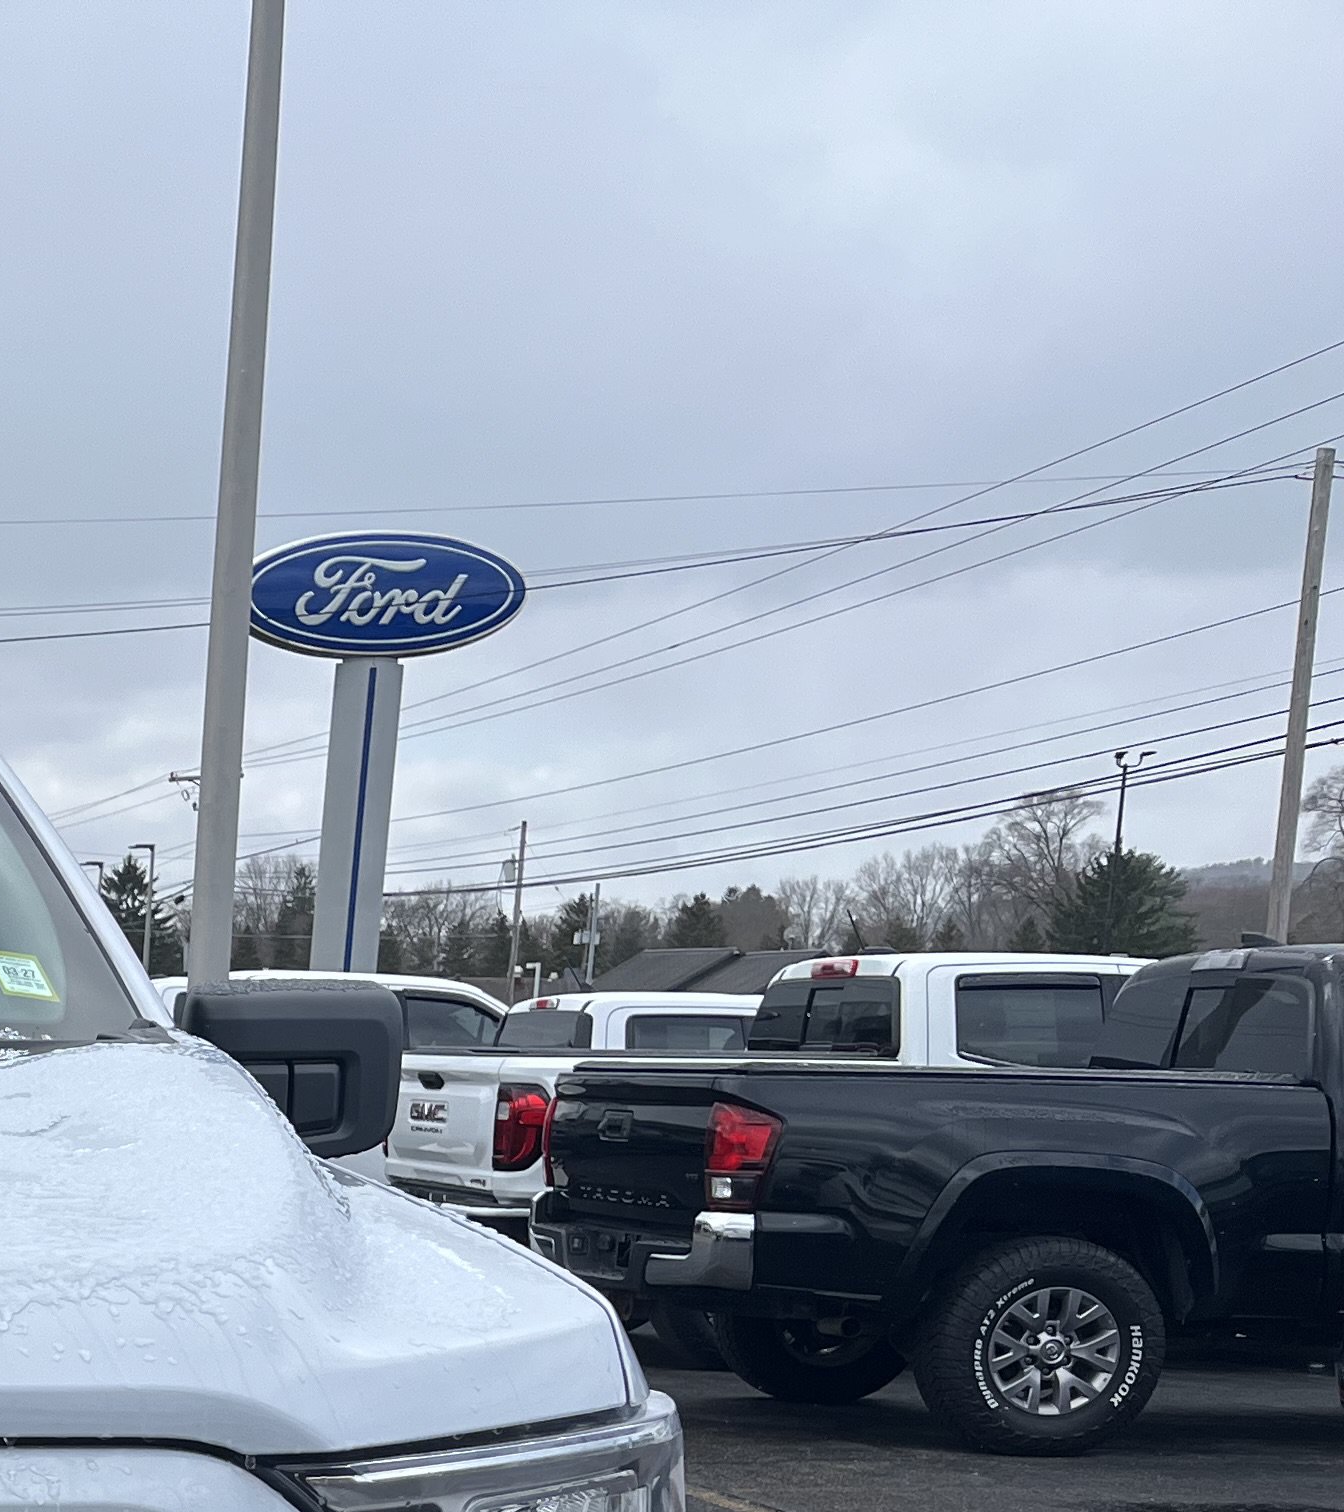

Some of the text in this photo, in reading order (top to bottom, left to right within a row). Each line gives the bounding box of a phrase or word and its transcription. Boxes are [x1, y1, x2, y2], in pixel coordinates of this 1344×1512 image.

[295, 555, 469, 626] Ford
[410, 1103, 448, 1123] GMC
[579, 1185, 671, 1208] TACOMA
[996, 1278, 1035, 1309] Xtreme
